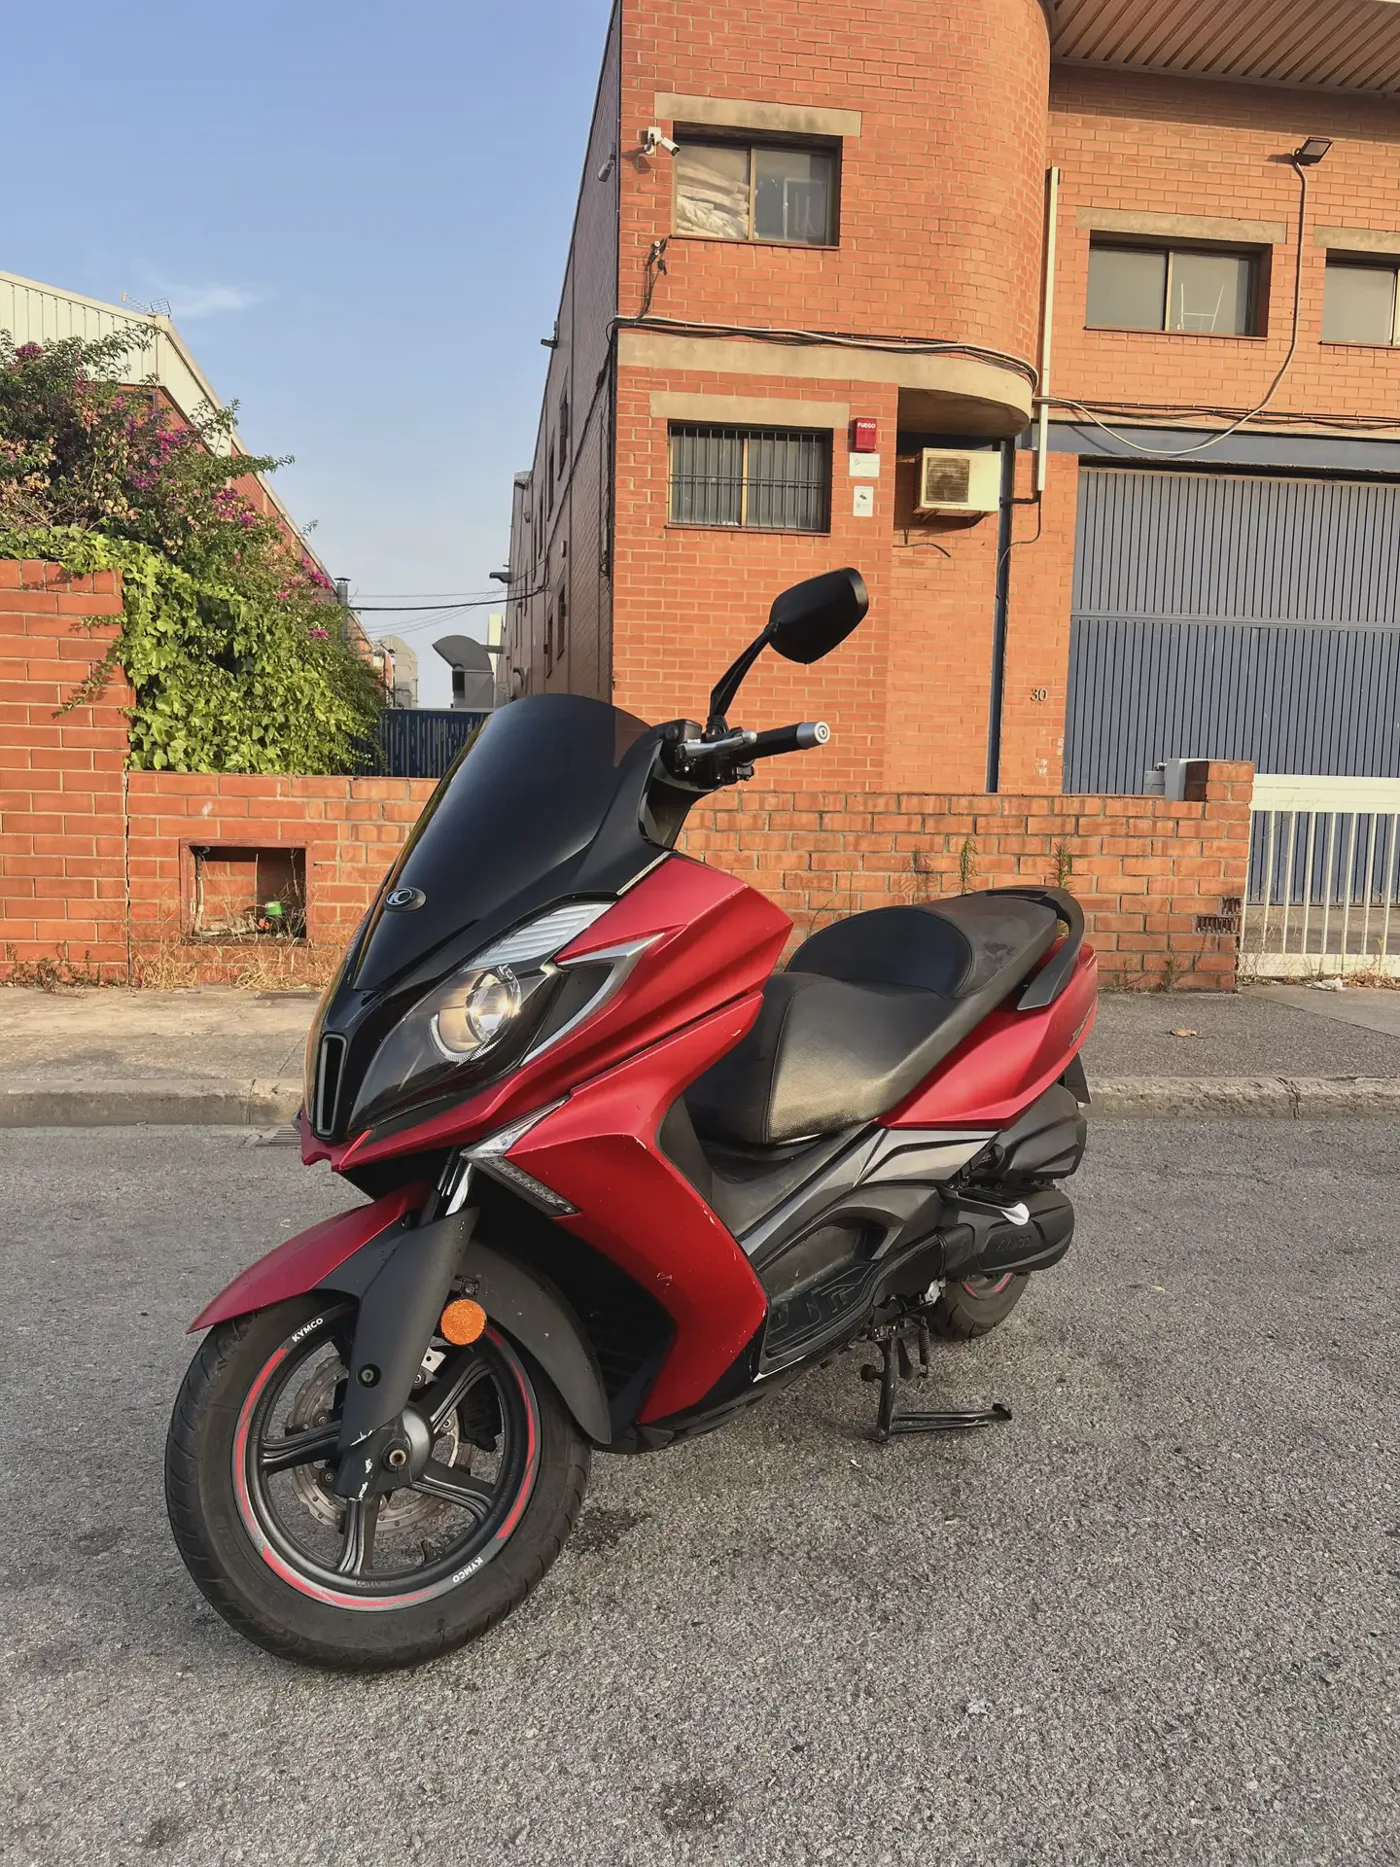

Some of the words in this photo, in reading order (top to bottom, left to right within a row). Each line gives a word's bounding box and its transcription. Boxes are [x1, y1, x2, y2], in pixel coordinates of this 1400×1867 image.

[1029, 688, 1047, 702] 30
[291, 1317, 324, 1343] KYMCO
[452, 1556, 484, 1583] KYMCO
